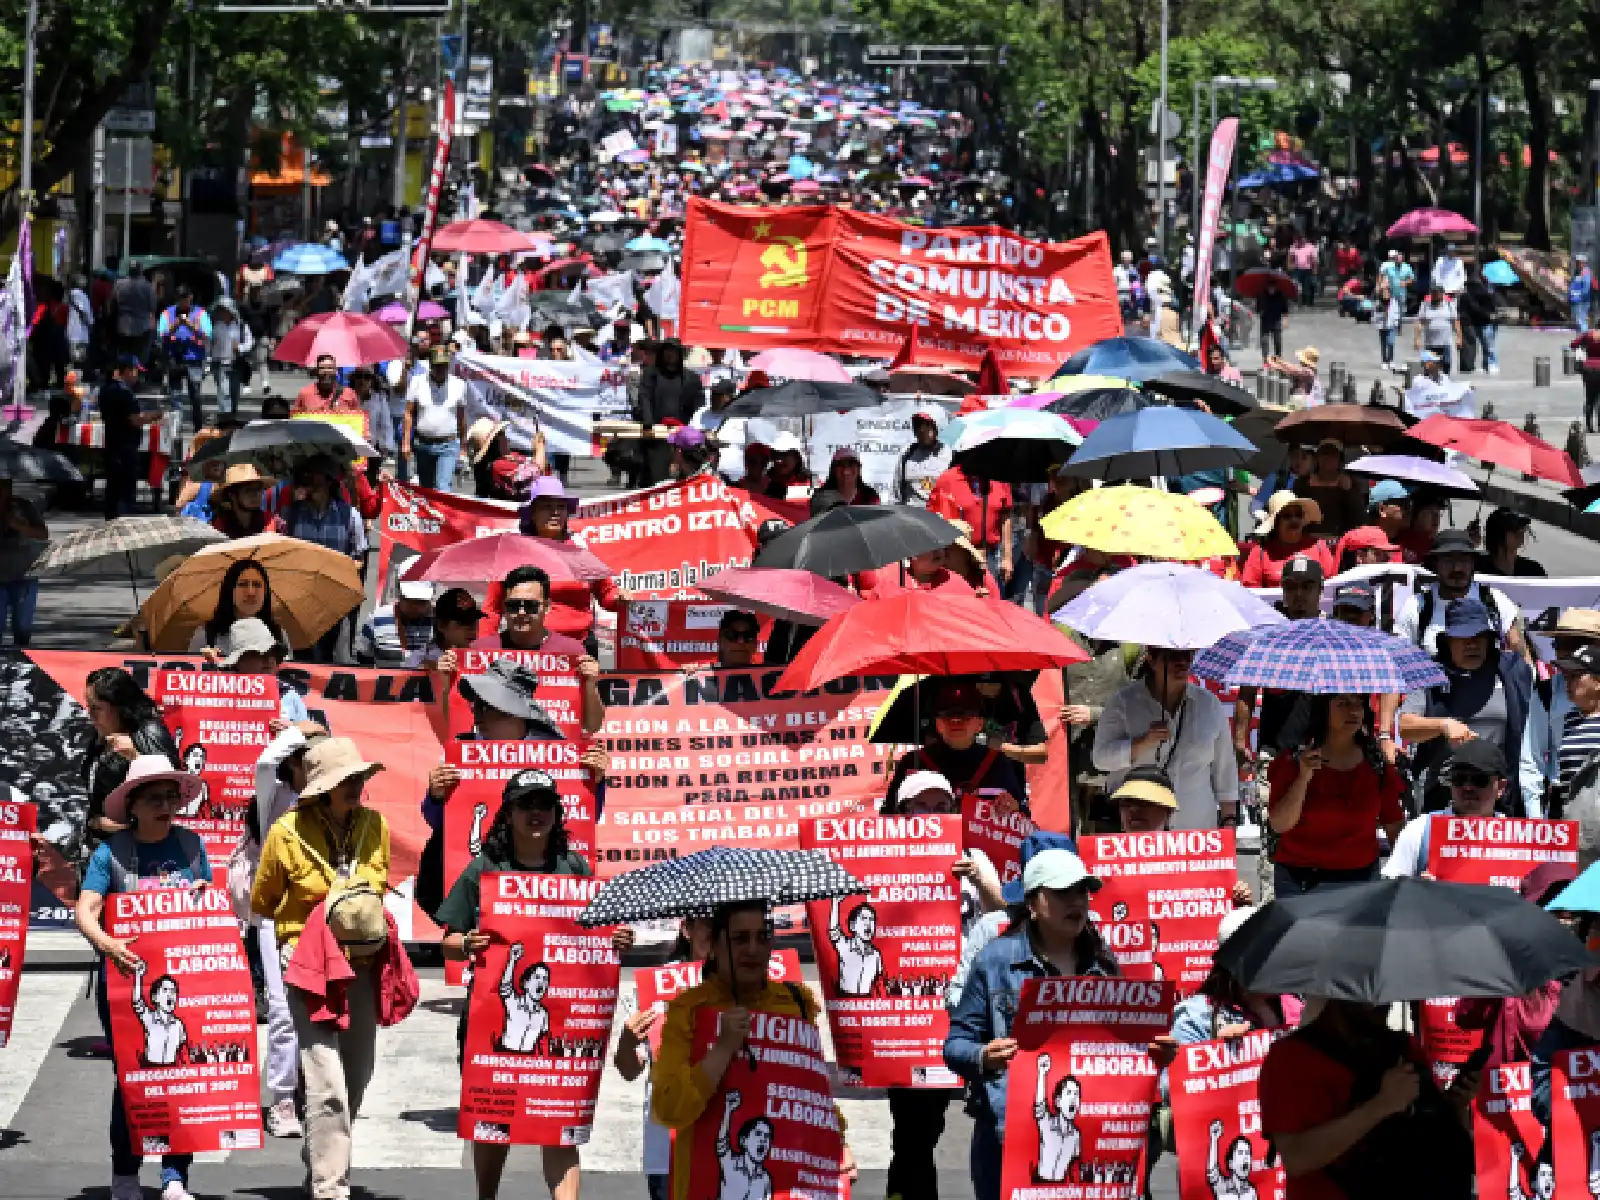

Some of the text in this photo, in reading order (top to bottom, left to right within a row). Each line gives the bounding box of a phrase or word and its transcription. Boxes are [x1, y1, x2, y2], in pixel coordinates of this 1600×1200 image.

[901, 230, 1044, 268] PARTIDO
[868, 259, 1075, 306] COMUNISTA
[742, 299, 799, 319] PCM
[875, 292, 1071, 341] DE MÉXICO
[855, 418, 912, 431] SINDICA
[648, 487, 682, 511] DE
[583, 508, 746, 544] CENTRO IZTA
[166, 673, 266, 697] EXIGIMOS
[322, 670, 360, 702] A
[373, 673, 437, 703] LA
[199, 719, 265, 733] SEGURIDAD
[597, 718, 669, 734] CIÓN
[675, 718, 694, 734] A
[698, 717, 731, 734] LA
[737, 712, 779, 730] LEY
[785, 710, 828, 727] DEL
[199, 734, 272, 747] LABORAL
[689, 734, 734, 751] SIN
[830, 725, 857, 741] NI
[460, 741, 580, 765] EXIGIMOS
[610, 755, 691, 771] RIDAD
[698, 749, 792, 770] SOCIAL
[799, 744, 865, 763] PARA
[603, 773, 669, 789] CIÓN
[675, 773, 694, 788] A
[698, 770, 732, 788] LA
[736, 763, 860, 784] REFORMA
[684, 783, 832, 806] PEÑA-AMLO
[613, 806, 737, 825] SALARIAL
[743, 804, 789, 821] DEL
[794, 796, 866, 819] 100%
[632, 822, 800, 844] LOS TRABAJA
[815, 816, 944, 842] EXIGIMOS
[1446, 818, 1570, 847] EXIGIMOS
[1096, 830, 1223, 861] EXIGIMOS
[499, 874, 607, 902] EXIGIMO
[863, 873, 946, 886] SEGURIDAD
[115, 888, 231, 919] EXIGIMOS
[865, 885, 958, 904] LABORAL
[1147, 886, 1227, 903] SEGURIDAD
[539, 904, 586, 919] AUMENT
[163, 942, 238, 961] SEGURIDAD
[1159, 940, 1219, 953] BASIFICAC
[166, 956, 247, 975] LABORAL
[1035, 979, 1163, 1006] EXIGIMOS
[828, 998, 892, 1012] BROGACIÓN
[894, 1000, 912, 1012] DE
[913, 1000, 931, 1012] LA
[903, 1014, 934, 1027] 2007
[471, 1053, 552, 1071] ABROGACIÓN
[554, 1058, 570, 1070] DE
[573, 1059, 587, 1071] LA
[1186, 1030, 1272, 1074] EXIGIM
[124, 1066, 197, 1083] ABROGACIÓN
[199, 1066, 218, 1077] DE
[219, 1065, 234, 1076] LA
[492, 1070, 516, 1084] DEL
[1070, 1055, 1157, 1076] LABORAL
[143, 1085, 166, 1099] DEL
